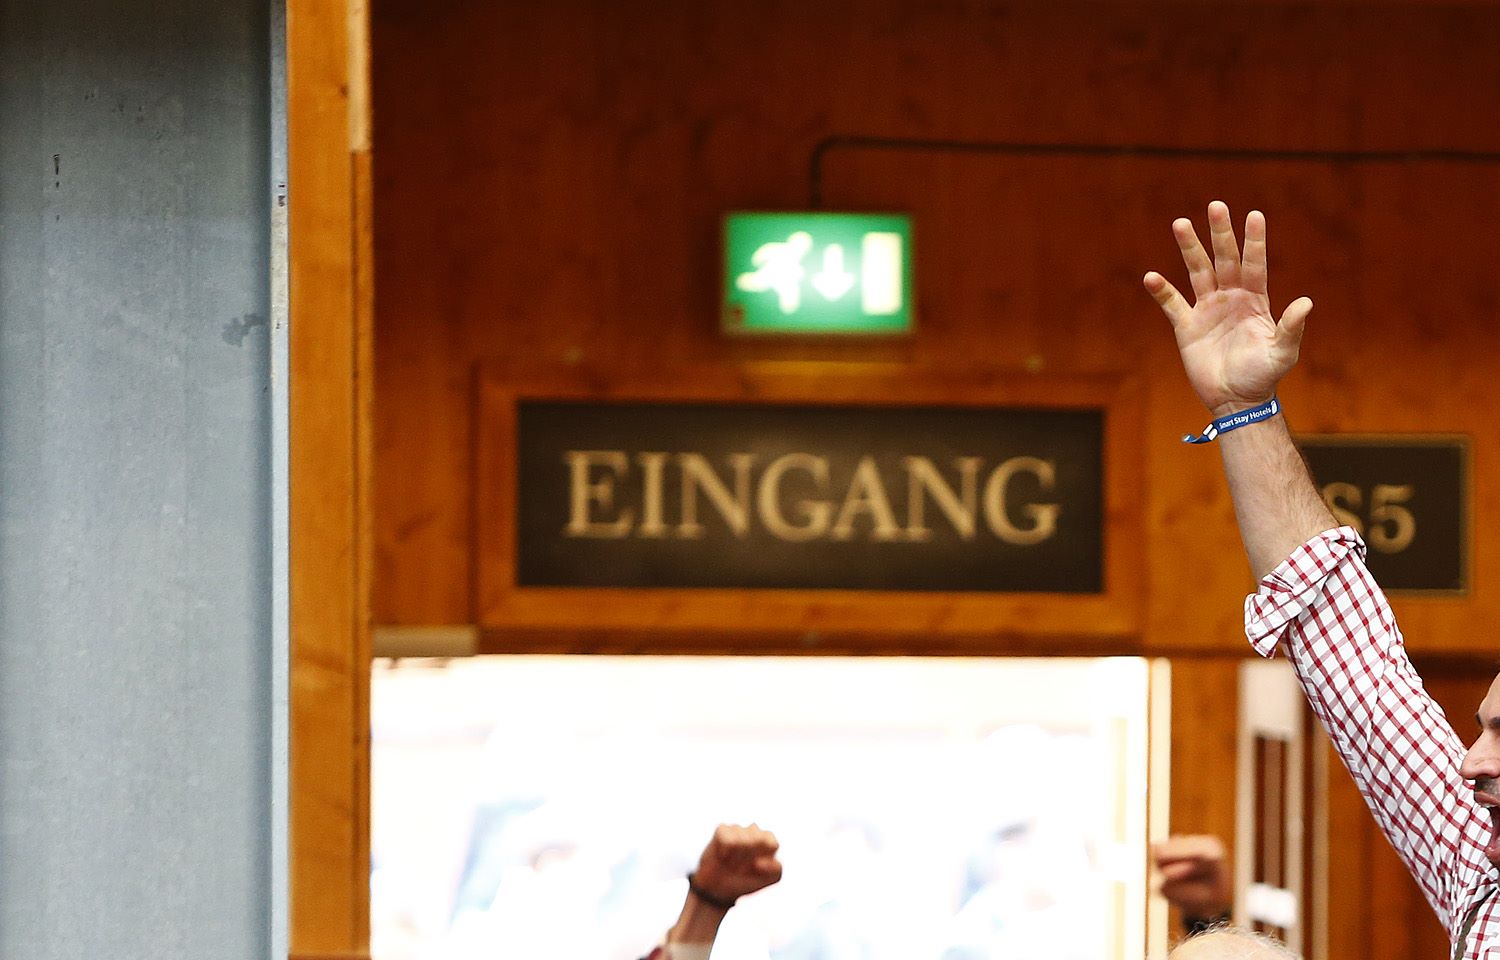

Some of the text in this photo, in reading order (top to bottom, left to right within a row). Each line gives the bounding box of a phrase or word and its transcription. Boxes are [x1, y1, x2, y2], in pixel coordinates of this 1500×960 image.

[1234, 415, 1249, 424] Stay
[1249, 408, 1271, 419] Hotels
[563, 449, 1059, 545] EINGANG
[1320, 481, 1416, 554] S5
